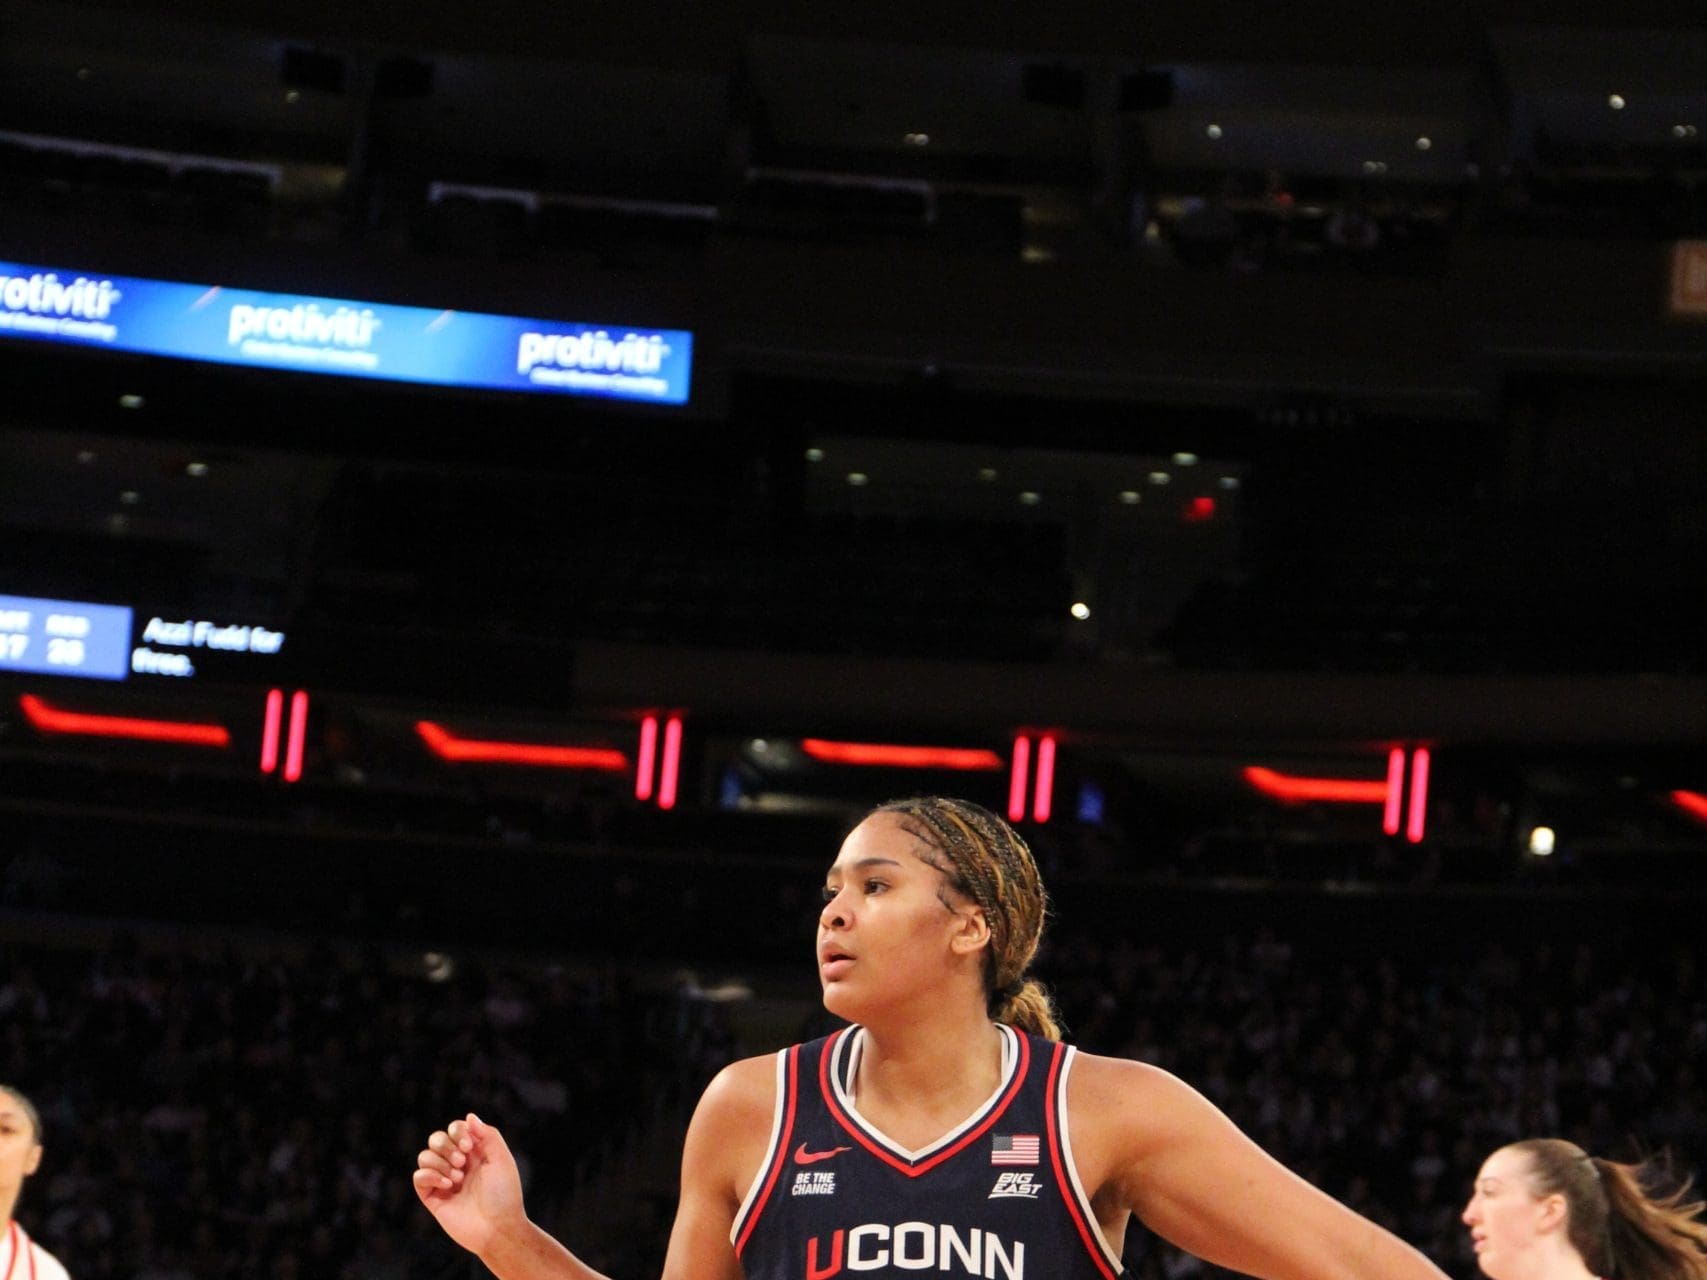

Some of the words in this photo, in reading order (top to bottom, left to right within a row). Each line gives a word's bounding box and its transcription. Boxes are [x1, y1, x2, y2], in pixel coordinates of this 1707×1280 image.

[228, 303, 374, 347] protiviti
[517, 330, 663, 375] protiviti
[796, 1172, 811, 1184] BE
[813, 1172, 835, 1183] THE
[998, 1172, 1034, 1184] BIG
[792, 1183, 836, 1196] CHANGE
[992, 1183, 1043, 1195] EAST
